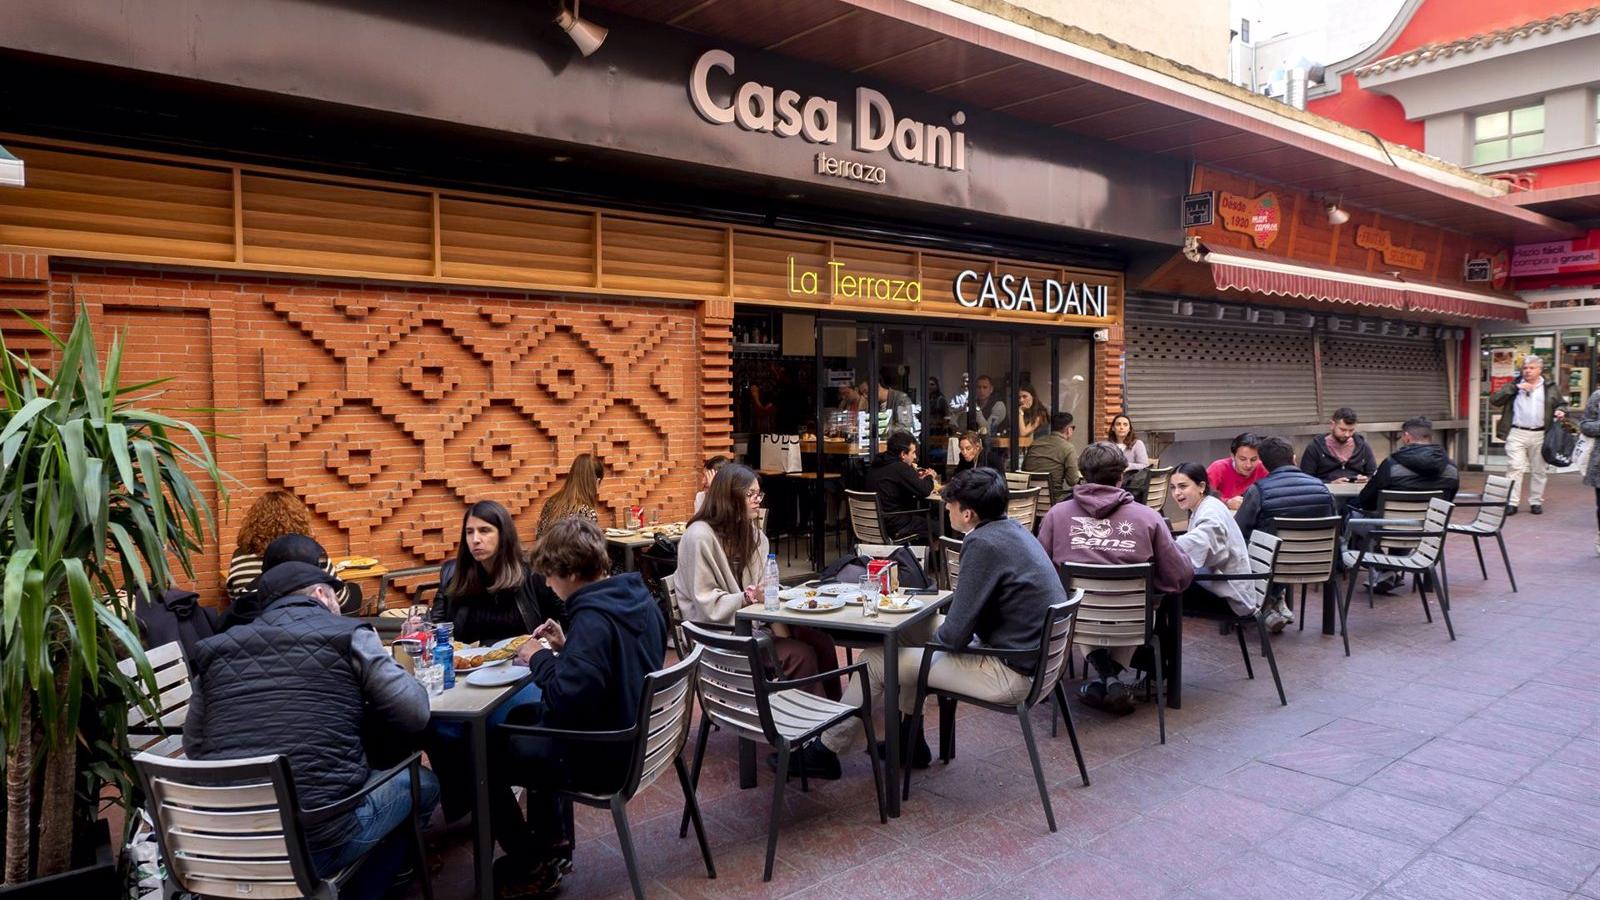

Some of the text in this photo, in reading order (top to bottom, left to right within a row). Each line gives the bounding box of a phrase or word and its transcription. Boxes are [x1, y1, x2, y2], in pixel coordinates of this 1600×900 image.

[689, 49, 965, 171] Casa Dani
[816, 152, 886, 185] terraza
[1222, 197, 1246, 212] Desde
[1514, 258, 1550, 267] compra
[789, 257, 922, 303] La Terraza
[954, 269, 1108, 317] CASA DANI
[1071, 537, 1136, 548] sans
